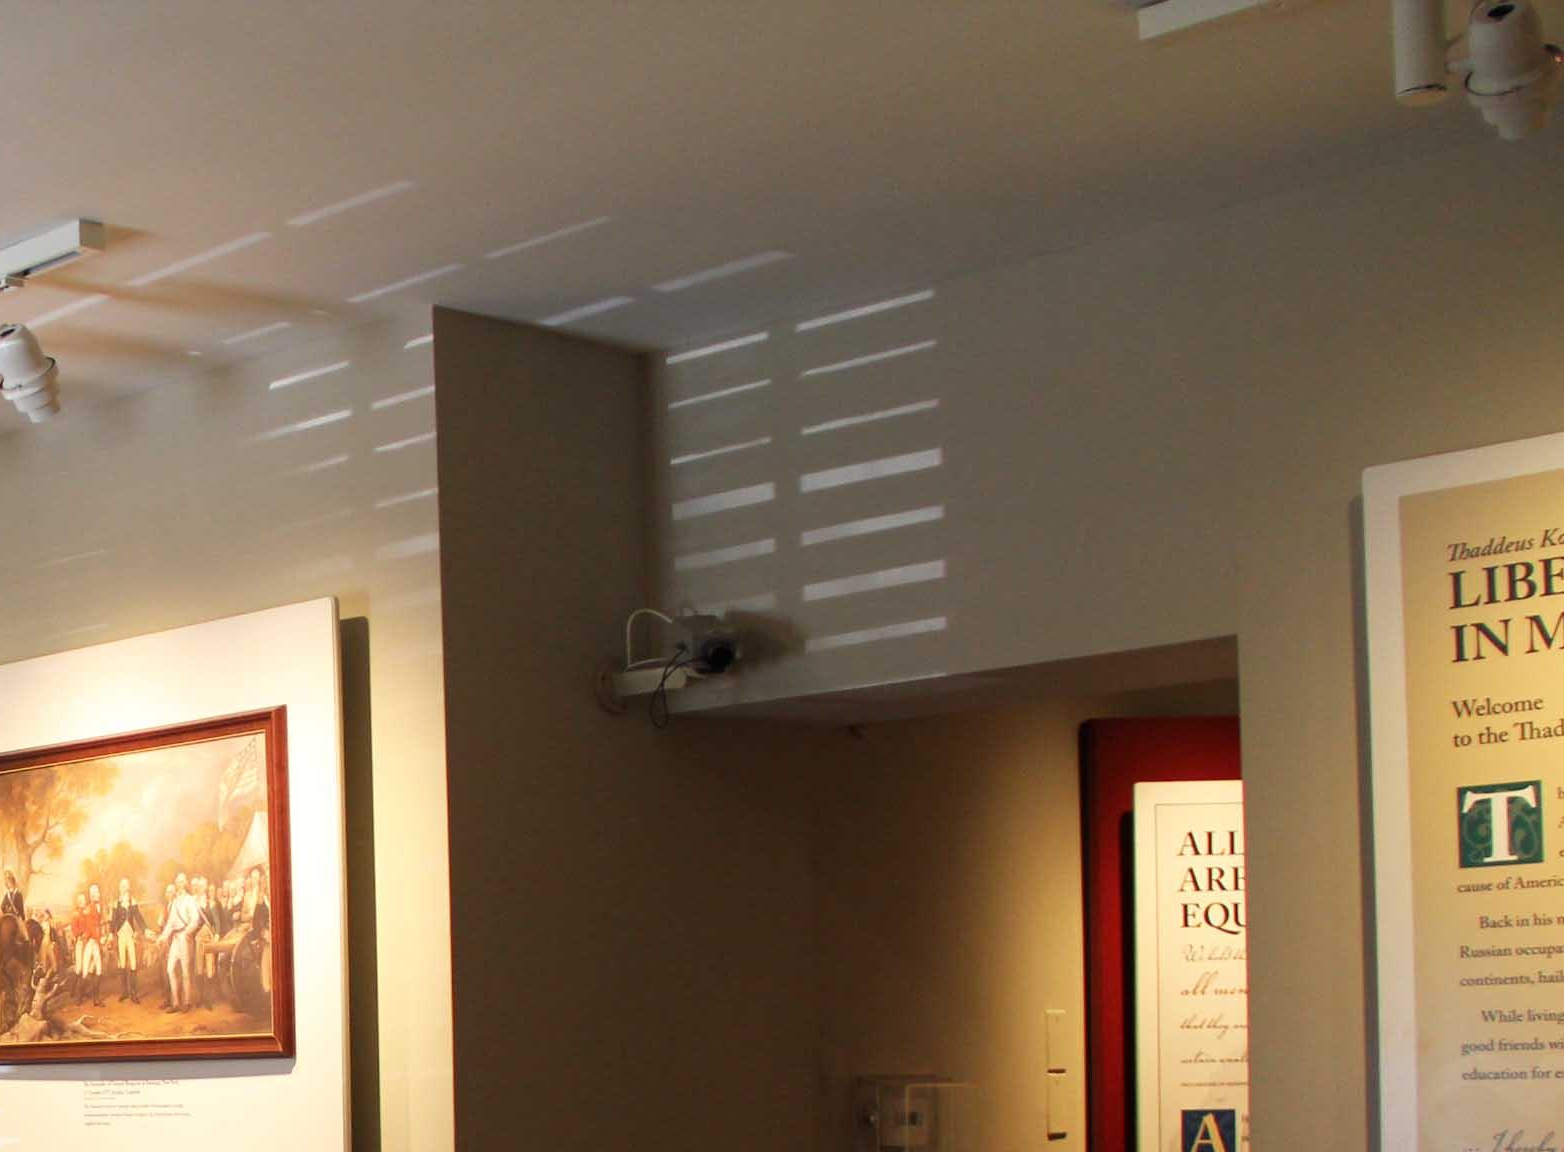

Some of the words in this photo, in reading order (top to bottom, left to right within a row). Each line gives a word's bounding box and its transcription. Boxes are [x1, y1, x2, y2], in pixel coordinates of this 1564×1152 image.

[1447, 536, 1534, 562] Thaddeus
[1448, 556, 1564, 611] LIBE
[1450, 618, 1513, 663] IN
[1452, 697, 1543, 719] Welcome
[1453, 733, 1472, 748] to
[1478, 726, 1509, 746] the
[1177, 831, 1245, 857] ALL
[1178, 867, 1246, 893] ARE
[1457, 881, 1492, 893] cause
[1495, 876, 1512, 890] of
[1479, 915, 1513, 930] Back
[1516, 914, 1530, 928] in
[1533, 912, 1553, 927] his
[1460, 944, 1512, 960] Russian
[1460, 972, 1534, 987] continents,
[1481, 1009, 1524, 1023] While
[1461, 1040, 1494, 1056] good
[1498, 1037, 1545, 1052] friends
[1461, 1067, 1527, 1081] education
[1531, 1066, 1551, 1080] for
